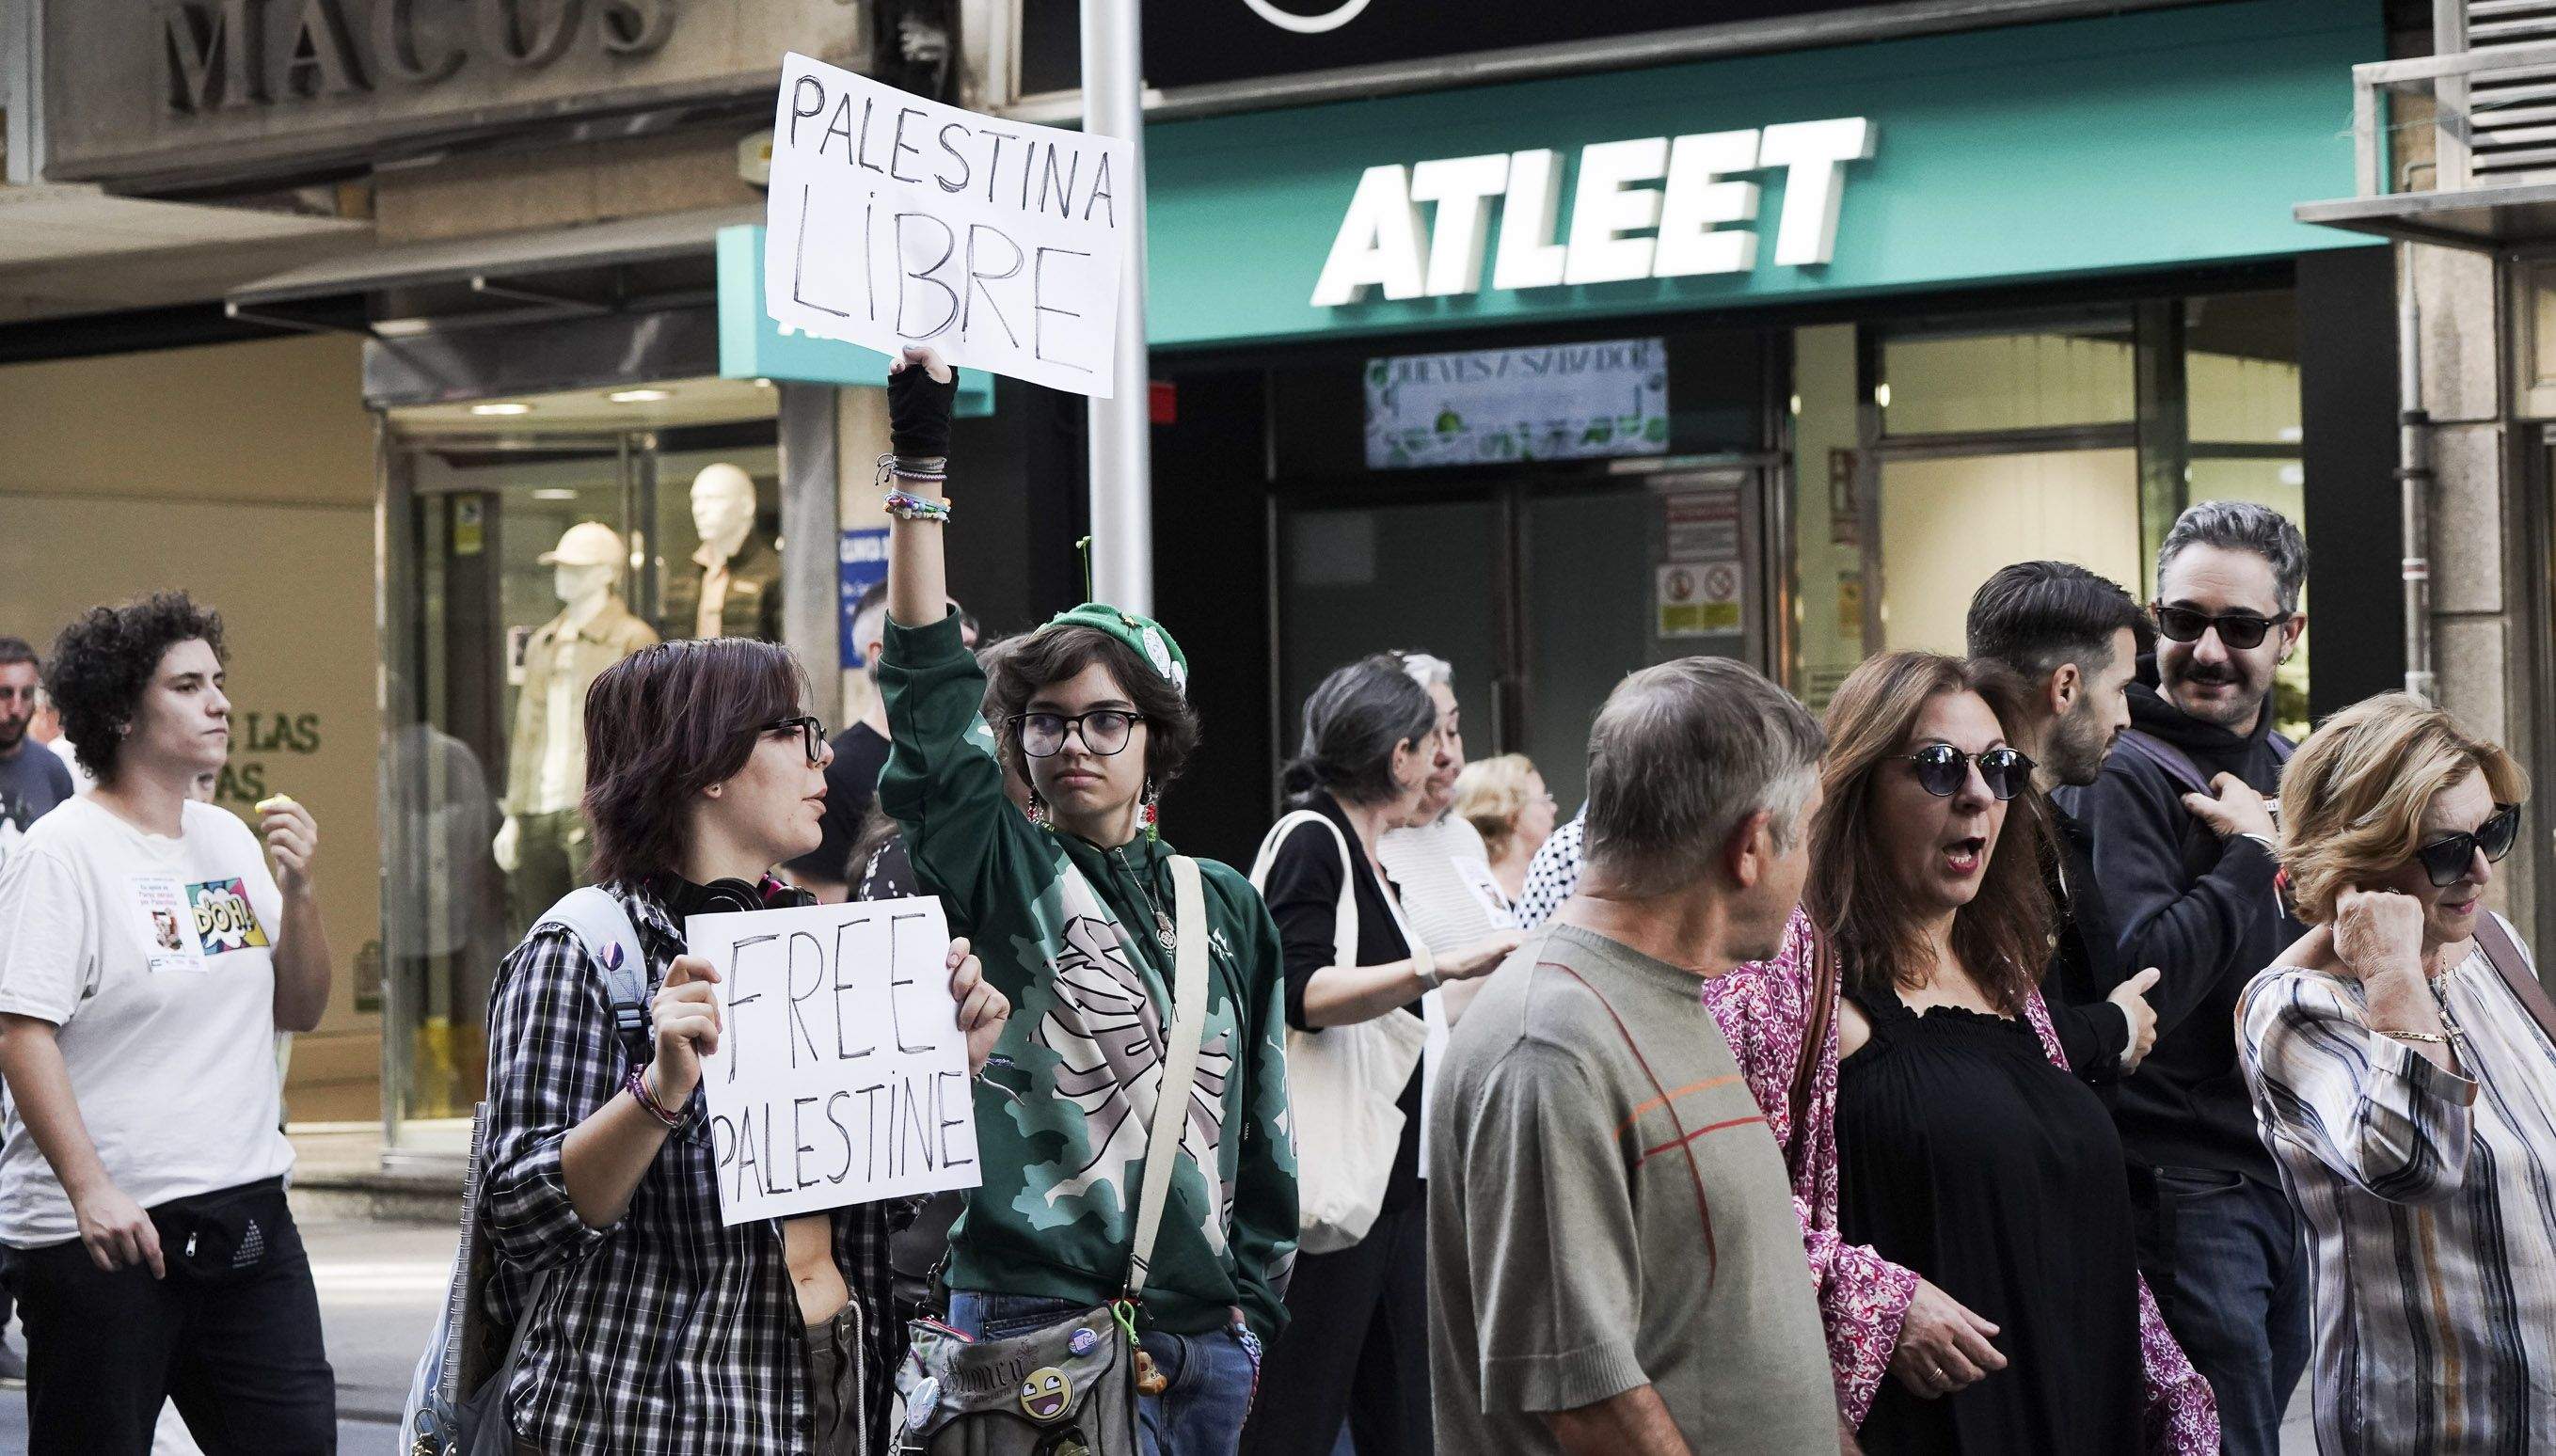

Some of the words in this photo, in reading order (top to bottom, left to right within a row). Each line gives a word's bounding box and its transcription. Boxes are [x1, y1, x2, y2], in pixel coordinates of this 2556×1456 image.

[790, 74, 1114, 229] PALESTINA
[1310, 116, 1875, 308] ATLEET
[246, 713, 320, 753] LAS
[727, 912, 937, 1084] FREE
